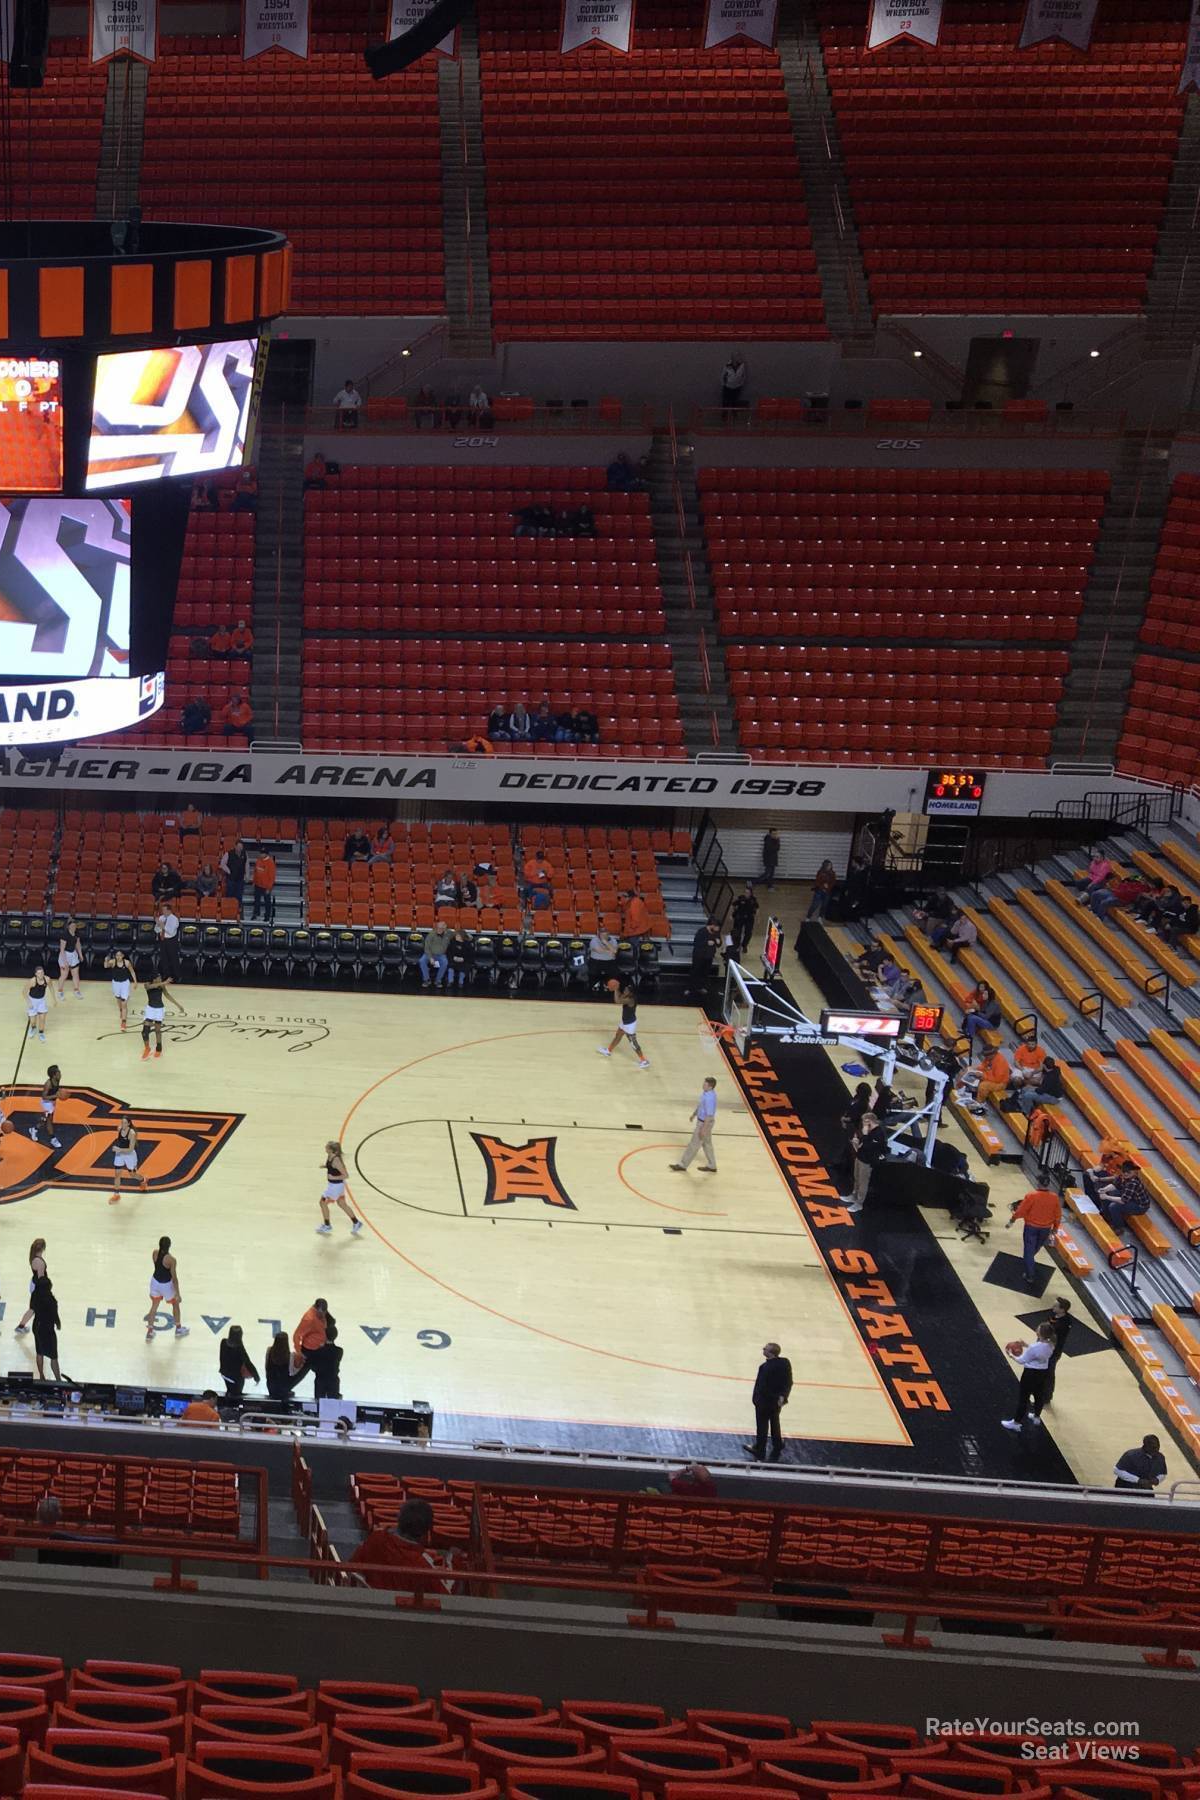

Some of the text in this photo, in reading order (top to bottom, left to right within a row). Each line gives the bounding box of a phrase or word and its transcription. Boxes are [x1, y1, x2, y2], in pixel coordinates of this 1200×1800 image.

[890, 0, 926, 8] COWBOY
[580, 5, 616, 14] COWBOY
[886, 8, 930, 17] WRESTLING
[107, 15, 141, 23] COWBOY
[259, 13, 294, 21] COWBOY
[900, 21, 912, 29] 23
[591, 27, 601, 35] 21
[14, 380, 32, 397] 0
[19, 401, 28, 412] F
[39, 401, 59, 412] PT
[453, 437, 500, 447] 204
[876, 439, 923, 450] 205
[275, 762, 438, 787] ARENA
[499, 772, 827, 796] DEDICATED 1938
[936, 785, 944, 796] 0
[973, 786, 982, 798] 0
[928, 802, 978, 810] HOMELAND
[197, 1012, 266, 1022] SUTTON
[915, 1007, 940, 1017] 36:57
[276, 1016, 327, 1025] EDDIE
[916, 1017, 934, 1029] 30
[829, 1248, 952, 1412] STATE
